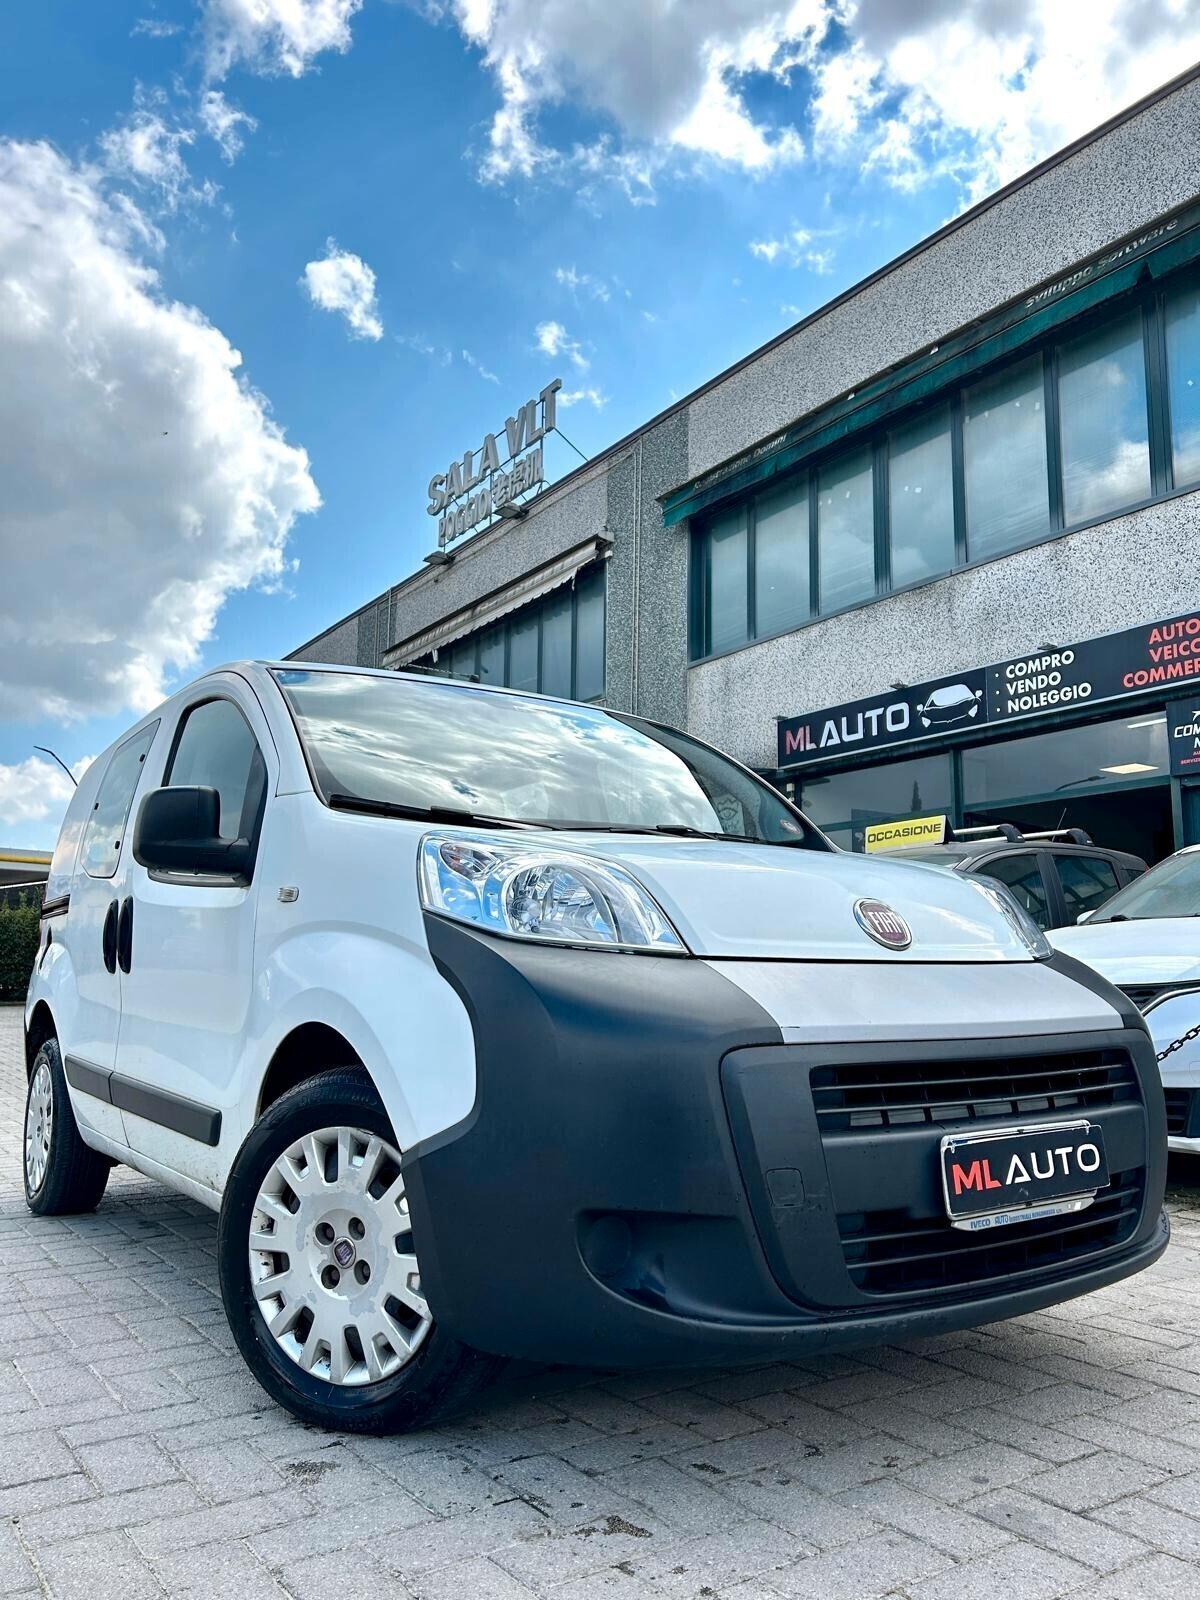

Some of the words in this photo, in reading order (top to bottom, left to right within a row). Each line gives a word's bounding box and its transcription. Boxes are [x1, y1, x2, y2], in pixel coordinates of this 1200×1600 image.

[427, 433, 500, 516] SALA
[505, 378, 562, 458] VLT
[438, 488, 492, 547] POGGIO
[1005, 650, 1075, 679] COMPRO
[1006, 671, 1061, 695] VENDO
[1007, 682, 1092, 713] NOLEGGIO
[868, 823, 942, 843] OCCASIONE
[867, 911, 902, 933] FIAT
[970, 1218, 991, 1229] IVECO
